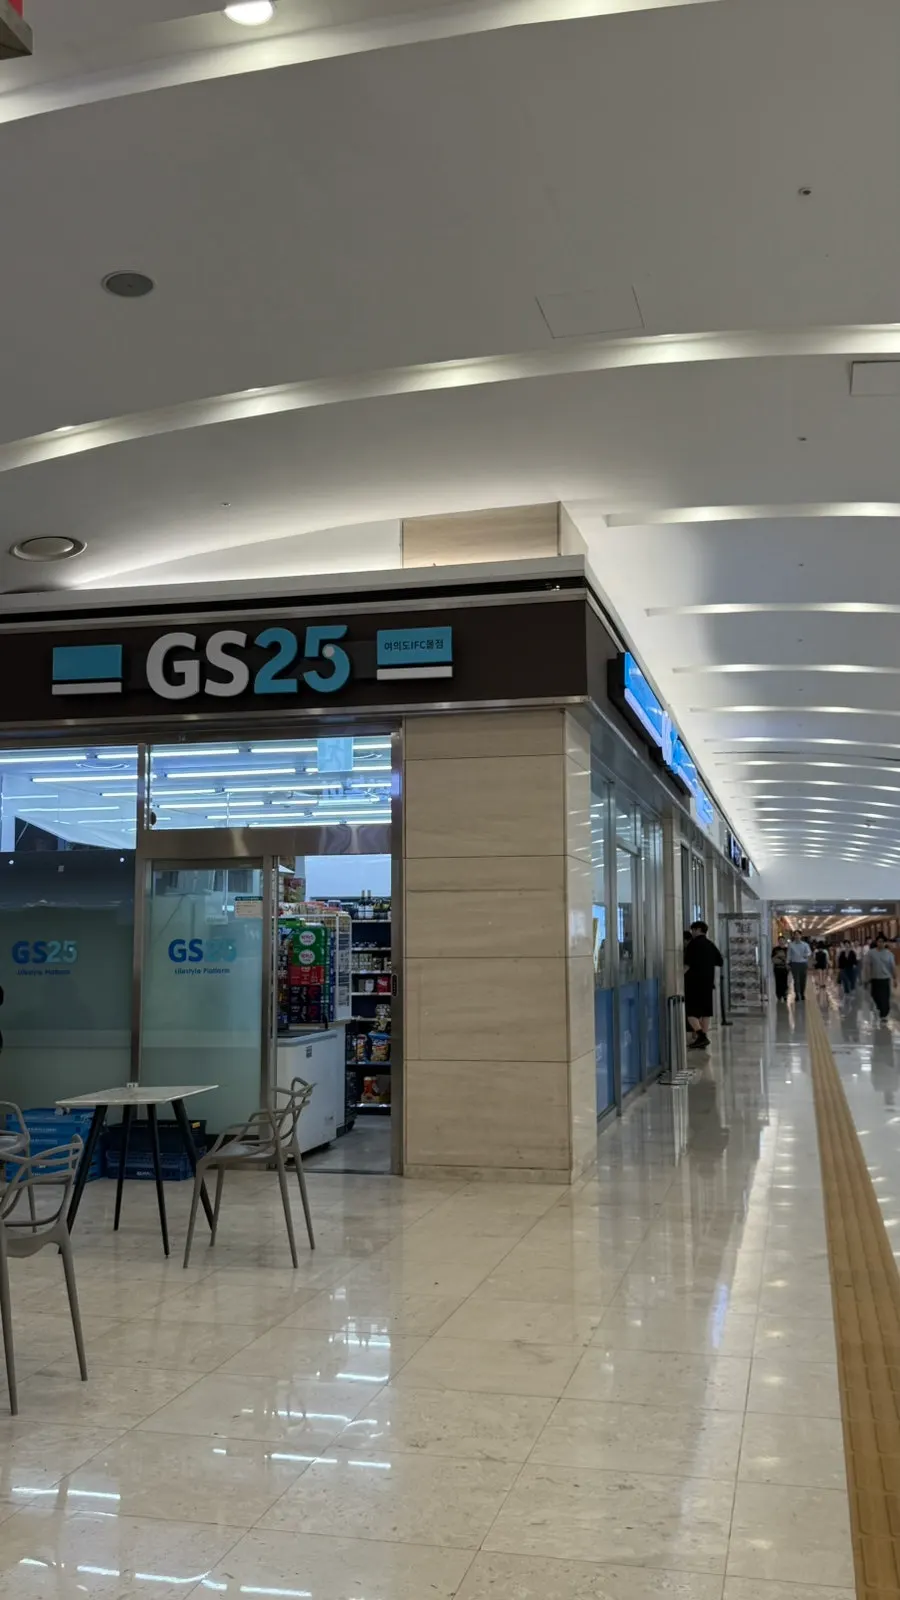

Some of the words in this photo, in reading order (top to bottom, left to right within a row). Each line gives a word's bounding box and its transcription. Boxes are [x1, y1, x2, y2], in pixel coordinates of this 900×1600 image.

[384, 638, 444, 651] 여의도IFC몰점
[146, 625, 351, 700] GS25
[12, 940, 78, 964] GS25
[168, 938, 238, 962] GS25
[174, 967, 201, 975] Lifestyle
